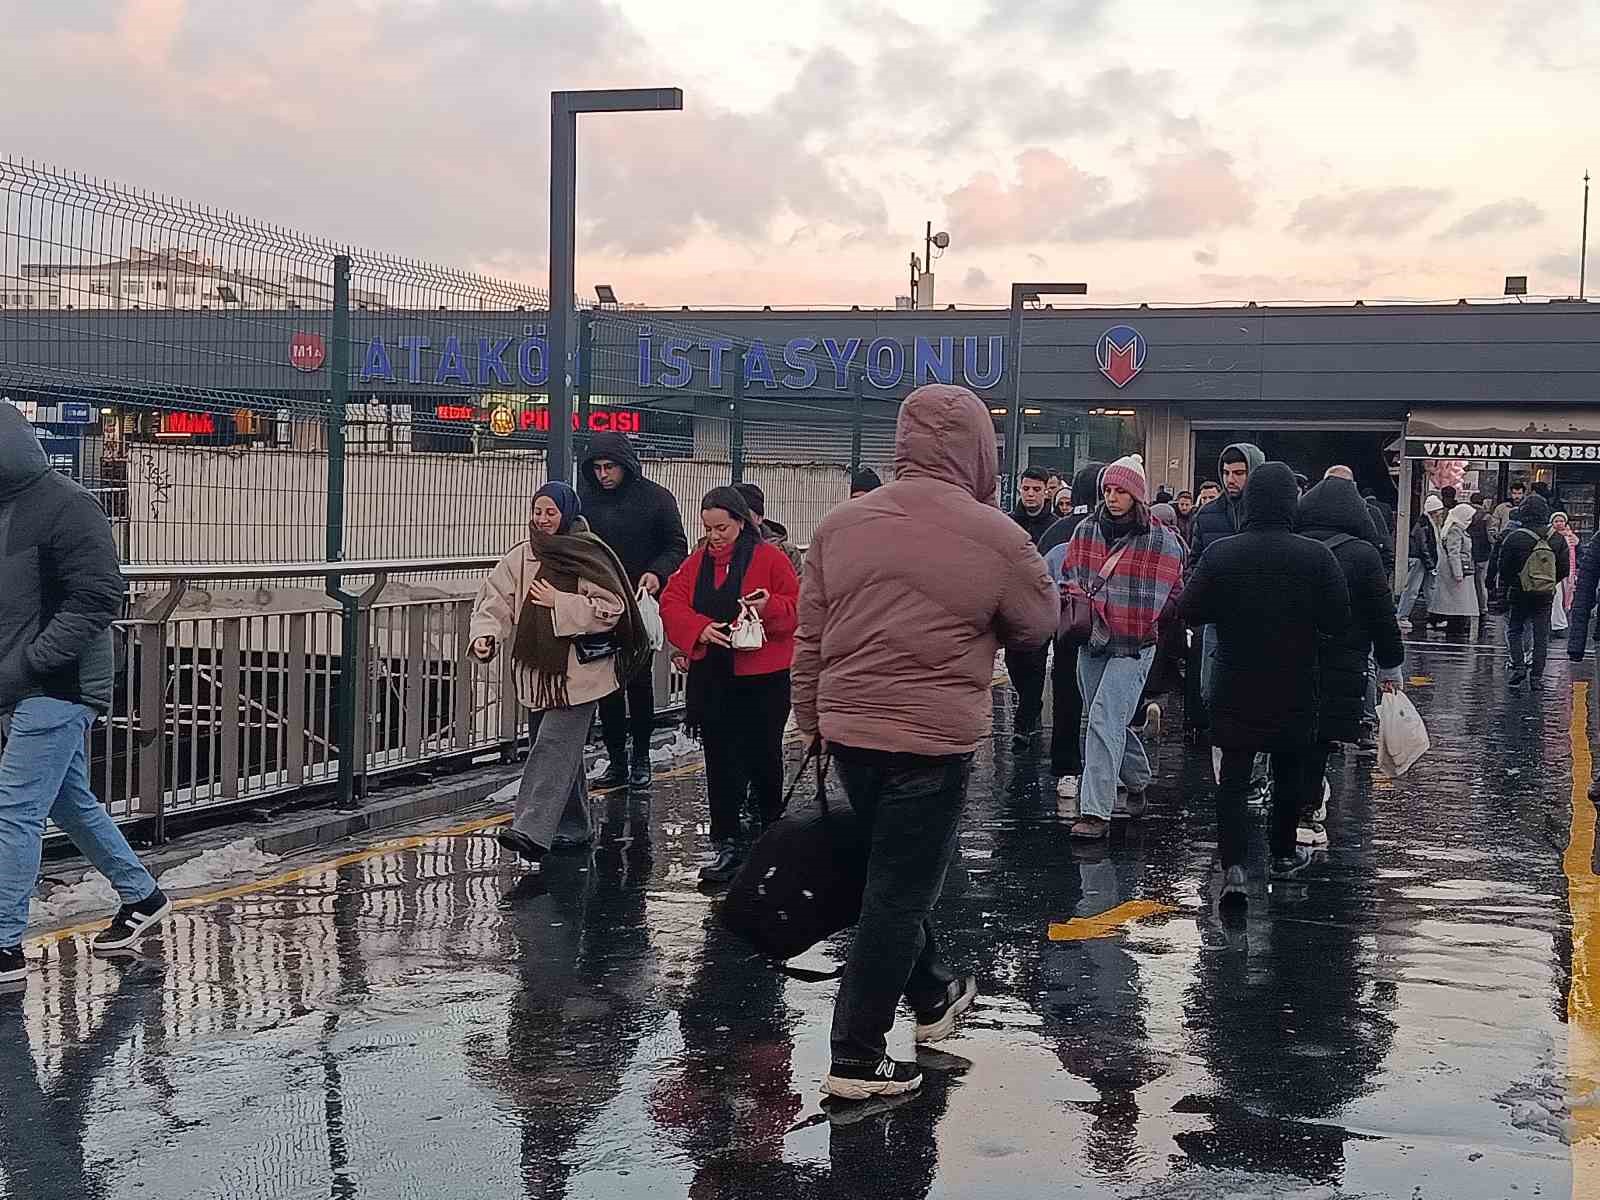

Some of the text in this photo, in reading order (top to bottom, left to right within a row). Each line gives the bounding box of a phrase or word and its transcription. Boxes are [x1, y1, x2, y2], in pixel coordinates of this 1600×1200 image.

[359, 324, 1003, 390] ATAKÖ İSTASYONU
[1423, 441, 1513, 457] VİTAMİN
